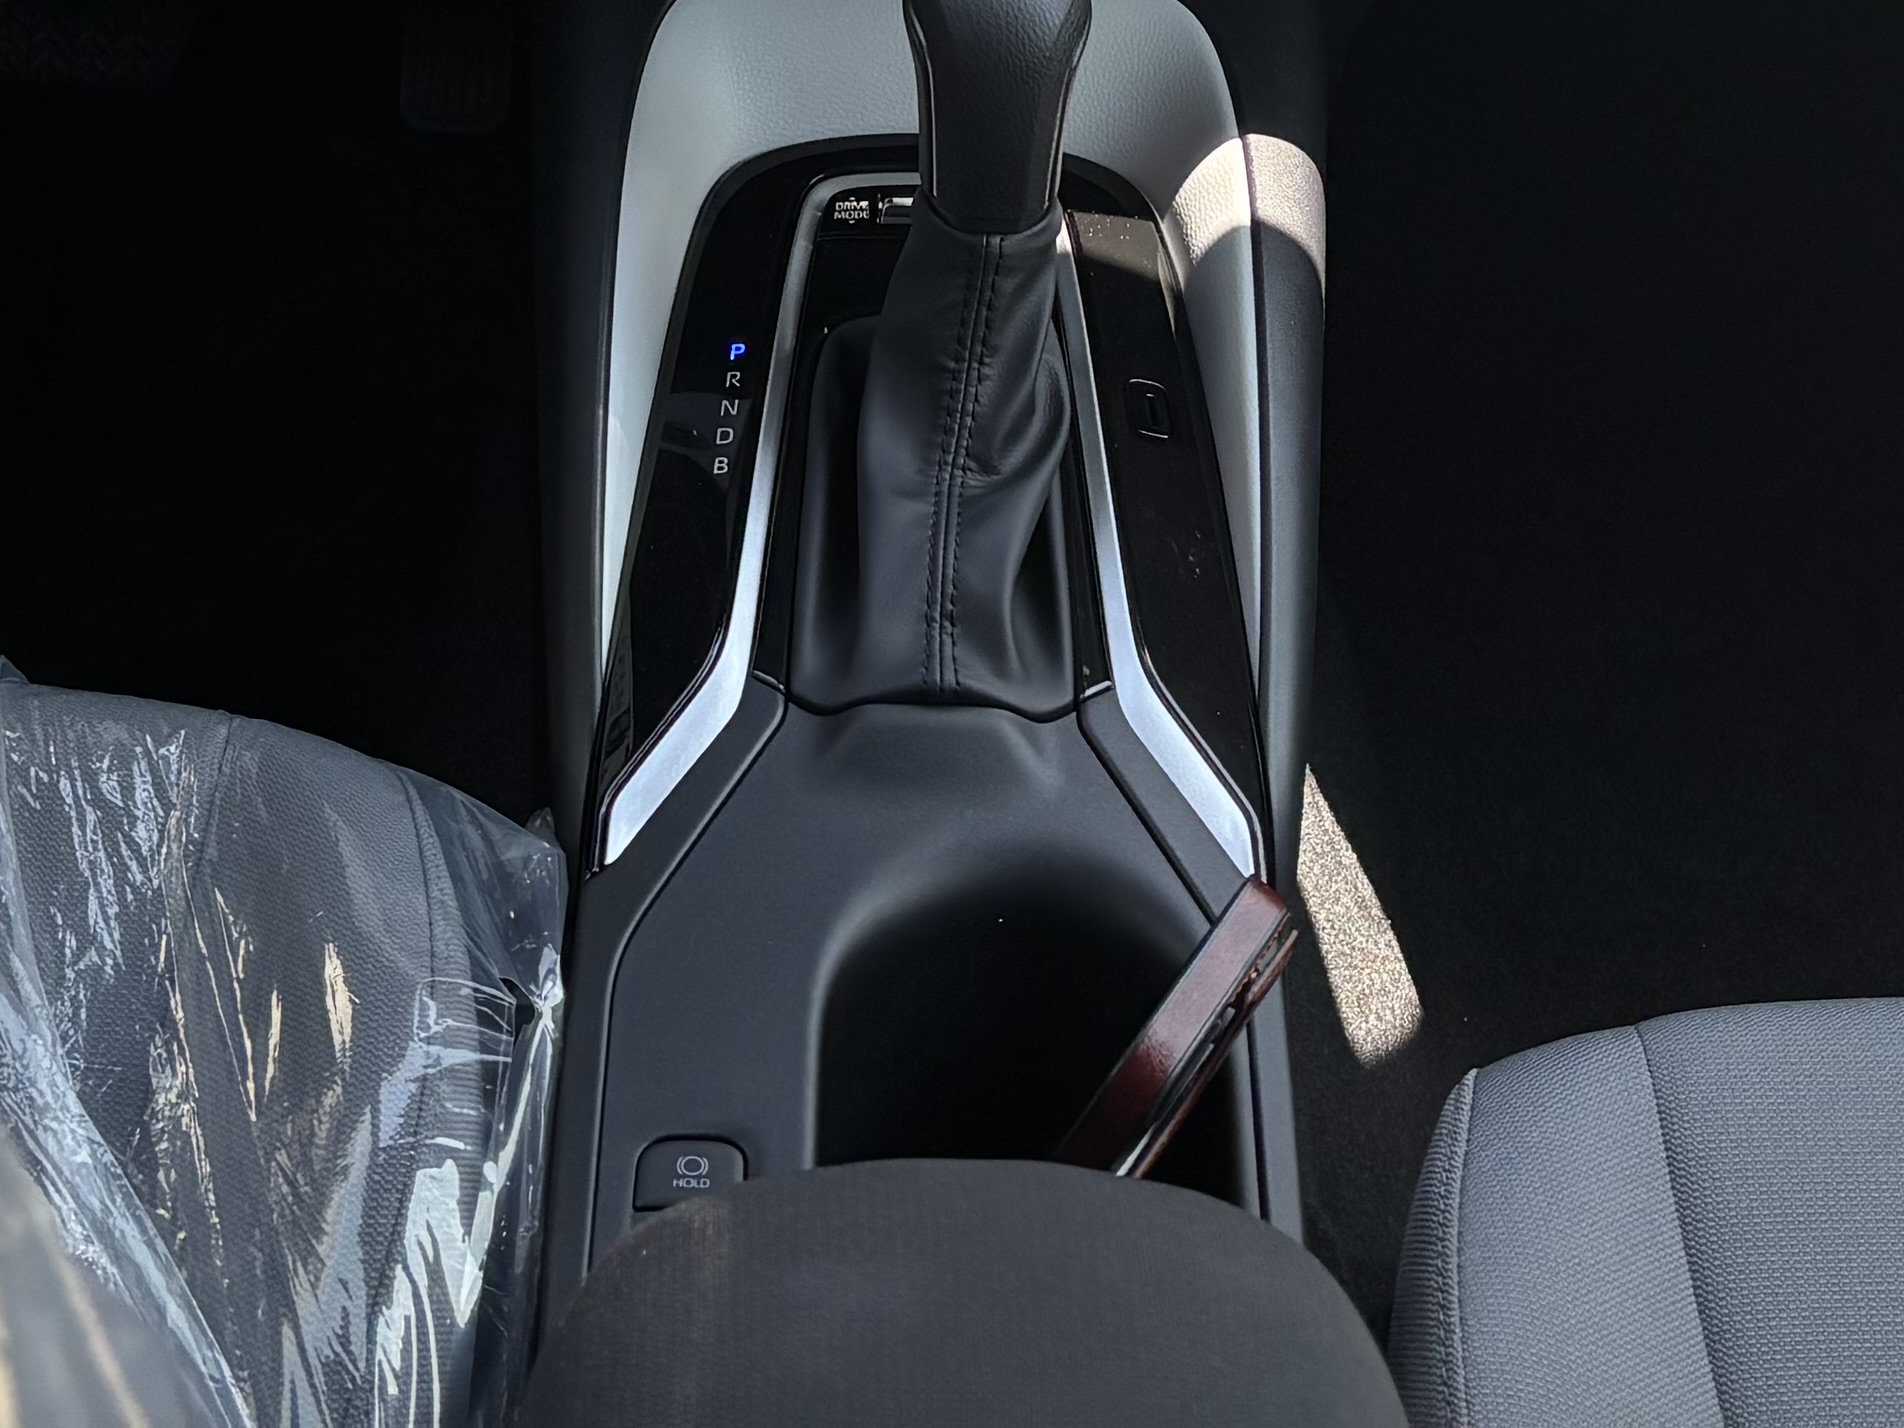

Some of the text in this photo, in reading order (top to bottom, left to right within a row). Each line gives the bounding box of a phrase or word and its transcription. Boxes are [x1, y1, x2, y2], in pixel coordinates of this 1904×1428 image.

[835, 200, 870, 212] DRIVE
[833, 210, 870, 221] MODE
[729, 343, 747, 361] P
[725, 371, 741, 388] R
[720, 399, 739, 417] N
[715, 427, 734, 445] D
[713, 456, 729, 474] B
[672, 1177, 711, 1189] HOLD
